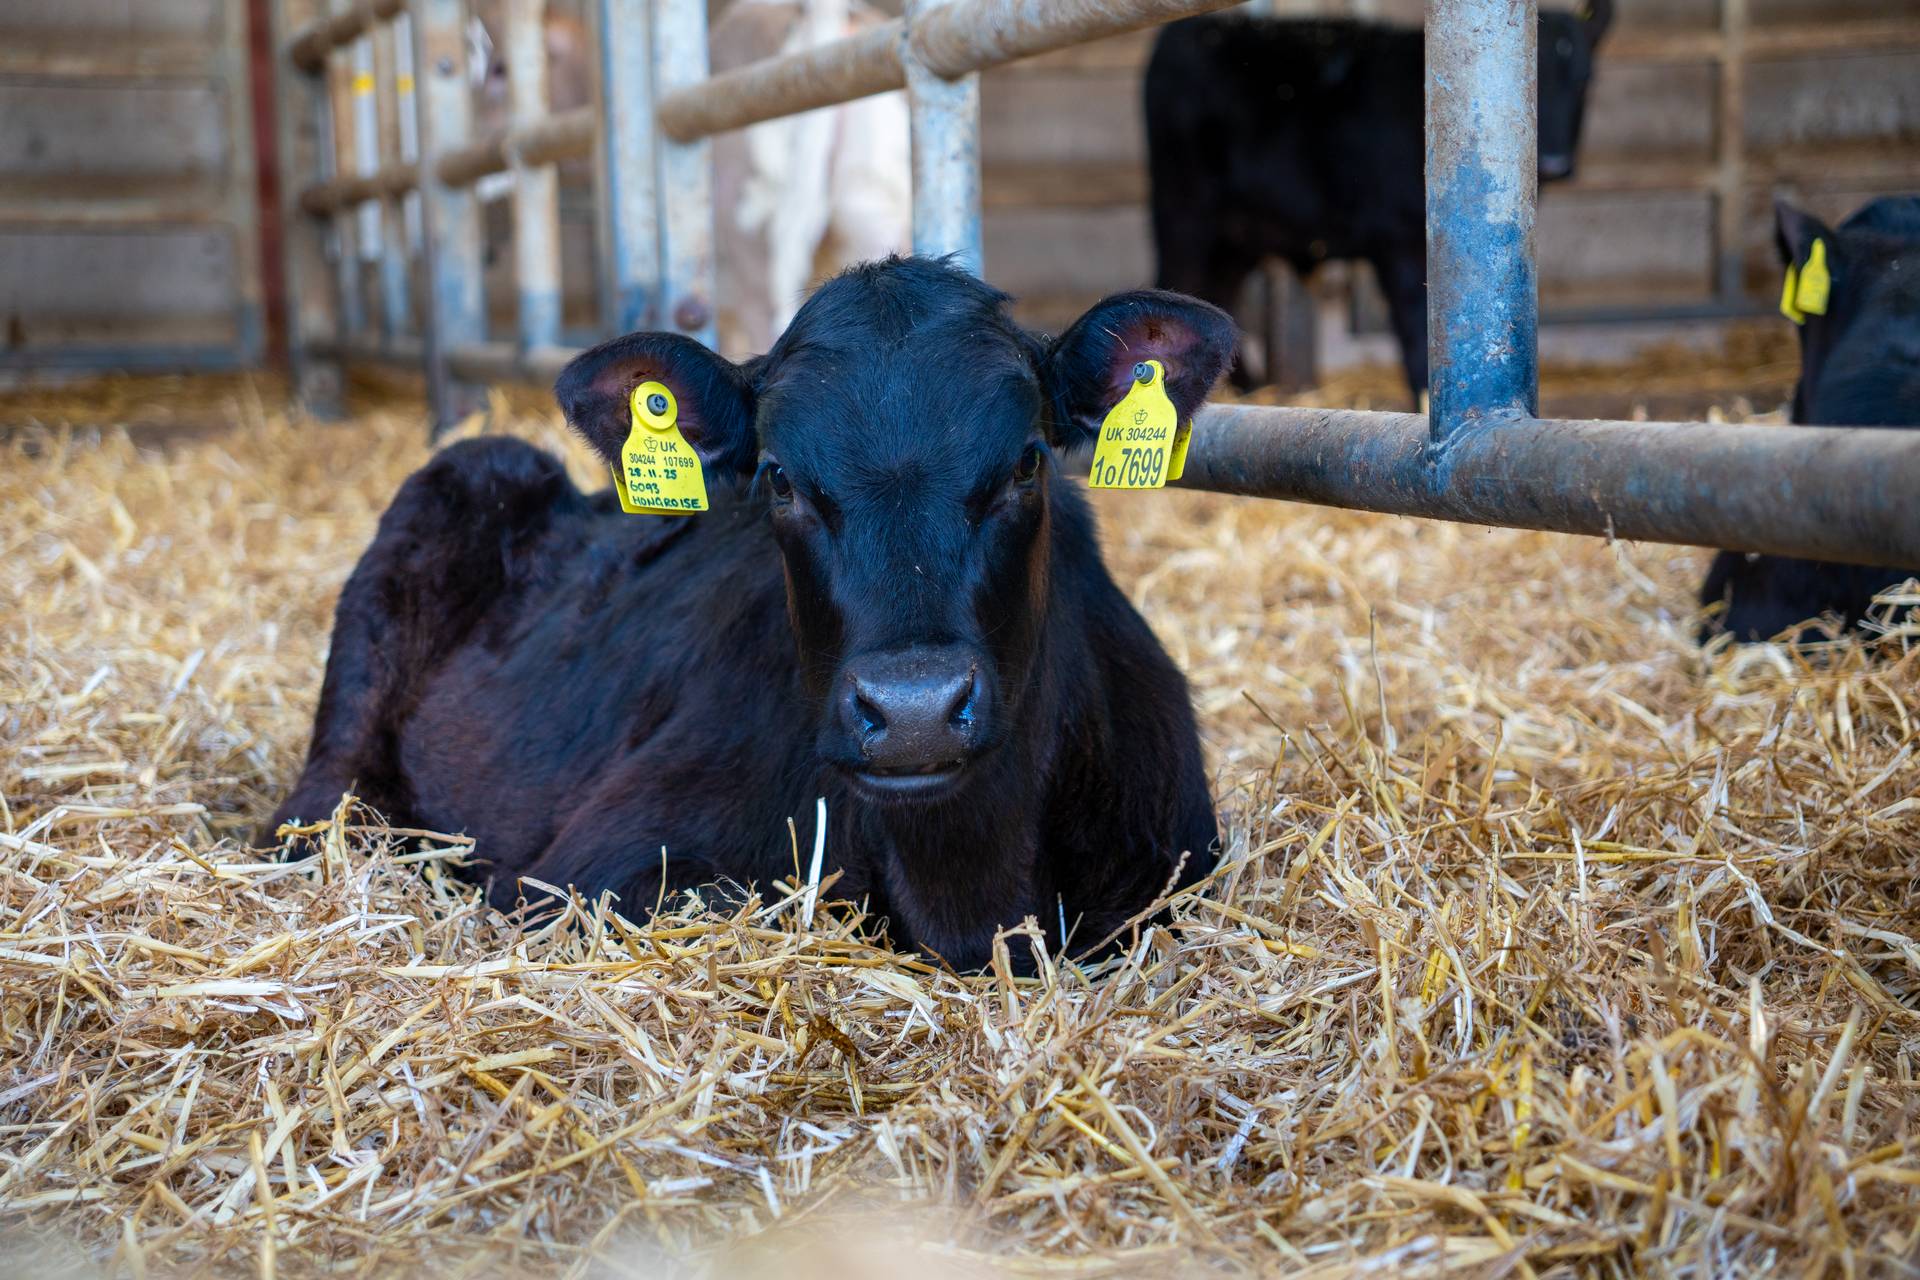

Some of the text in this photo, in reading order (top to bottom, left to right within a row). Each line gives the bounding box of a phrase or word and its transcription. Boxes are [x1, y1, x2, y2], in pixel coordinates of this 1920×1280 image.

[1106, 427, 1167, 441] UK 304244
[661, 441, 678, 453] UK
[629, 453, 694, 468] 304244 107699
[630, 481, 660, 495] 6093
